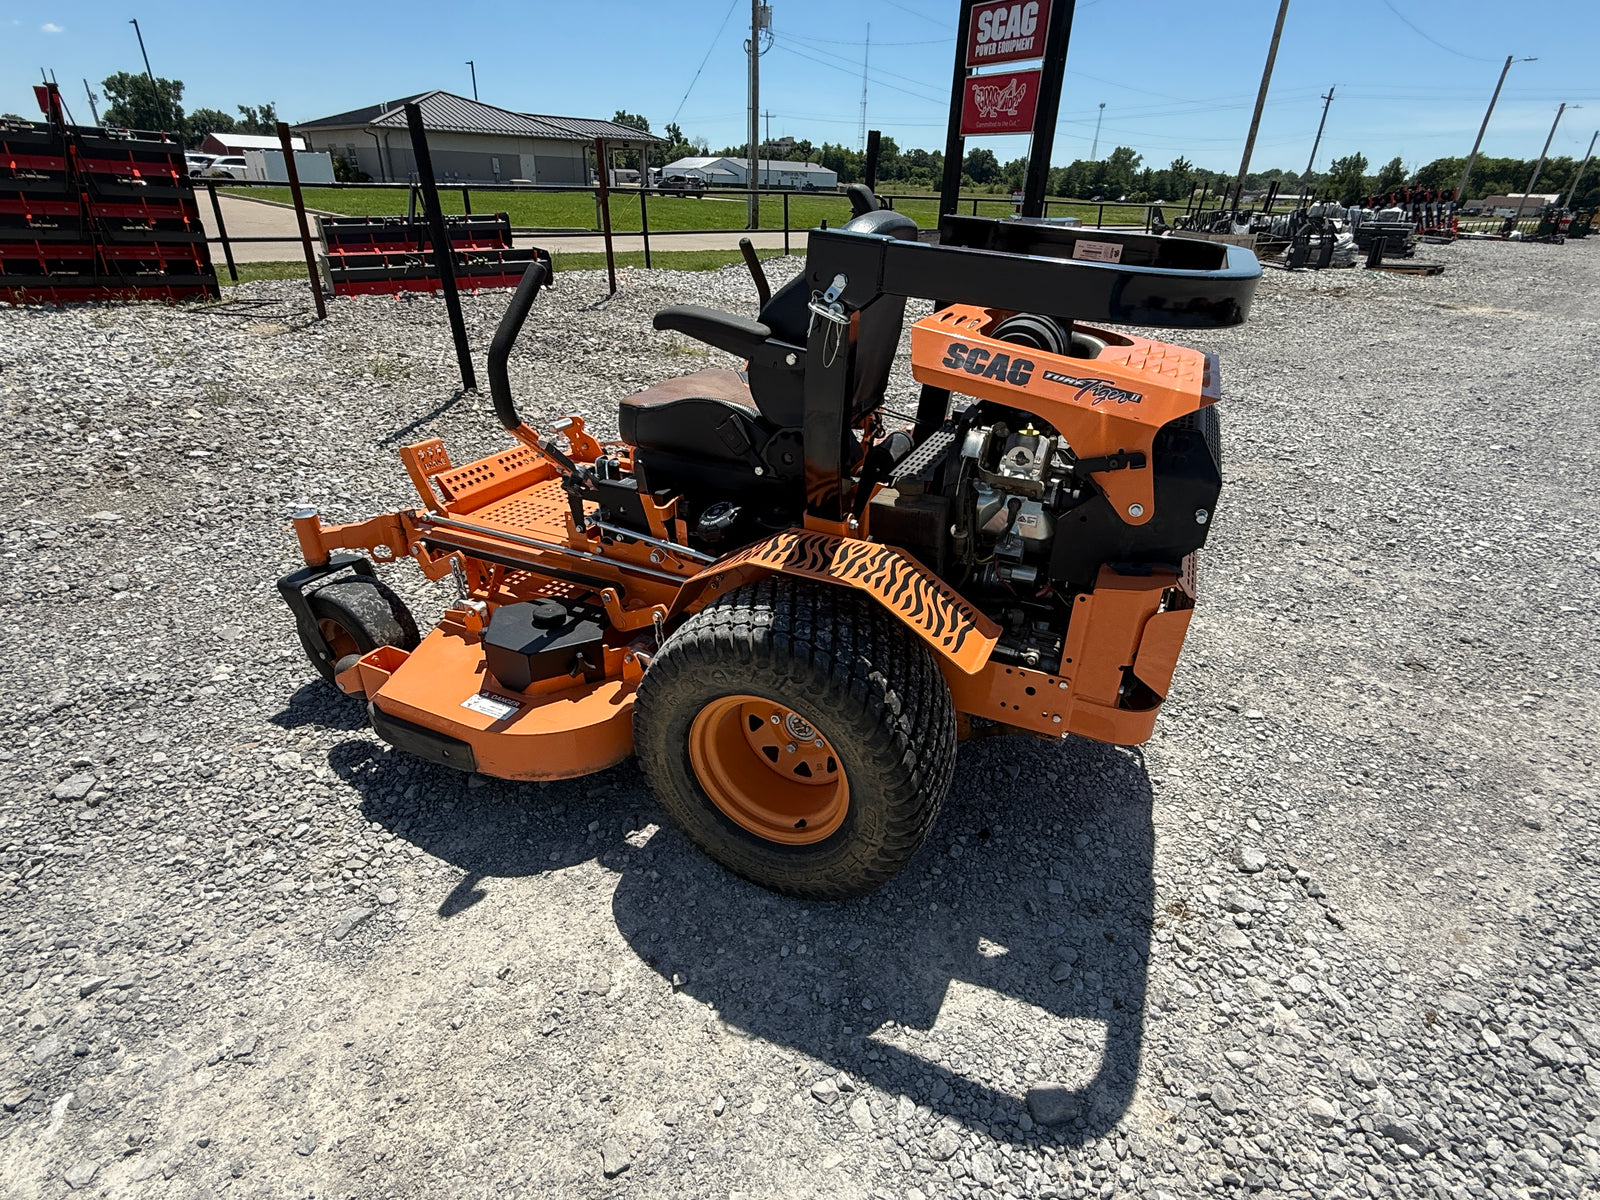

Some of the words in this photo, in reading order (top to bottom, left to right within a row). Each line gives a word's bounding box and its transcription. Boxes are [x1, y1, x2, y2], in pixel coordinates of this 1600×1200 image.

[976, 1, 1038, 42] SCAG
[974, 42, 998, 58] POWER
[997, 36, 1035, 54] EQUIPMENT
[942, 342, 1035, 386] SCAG
[1074, 378, 1128, 406] Tiger
[491, 695, 520, 707] DANGER
